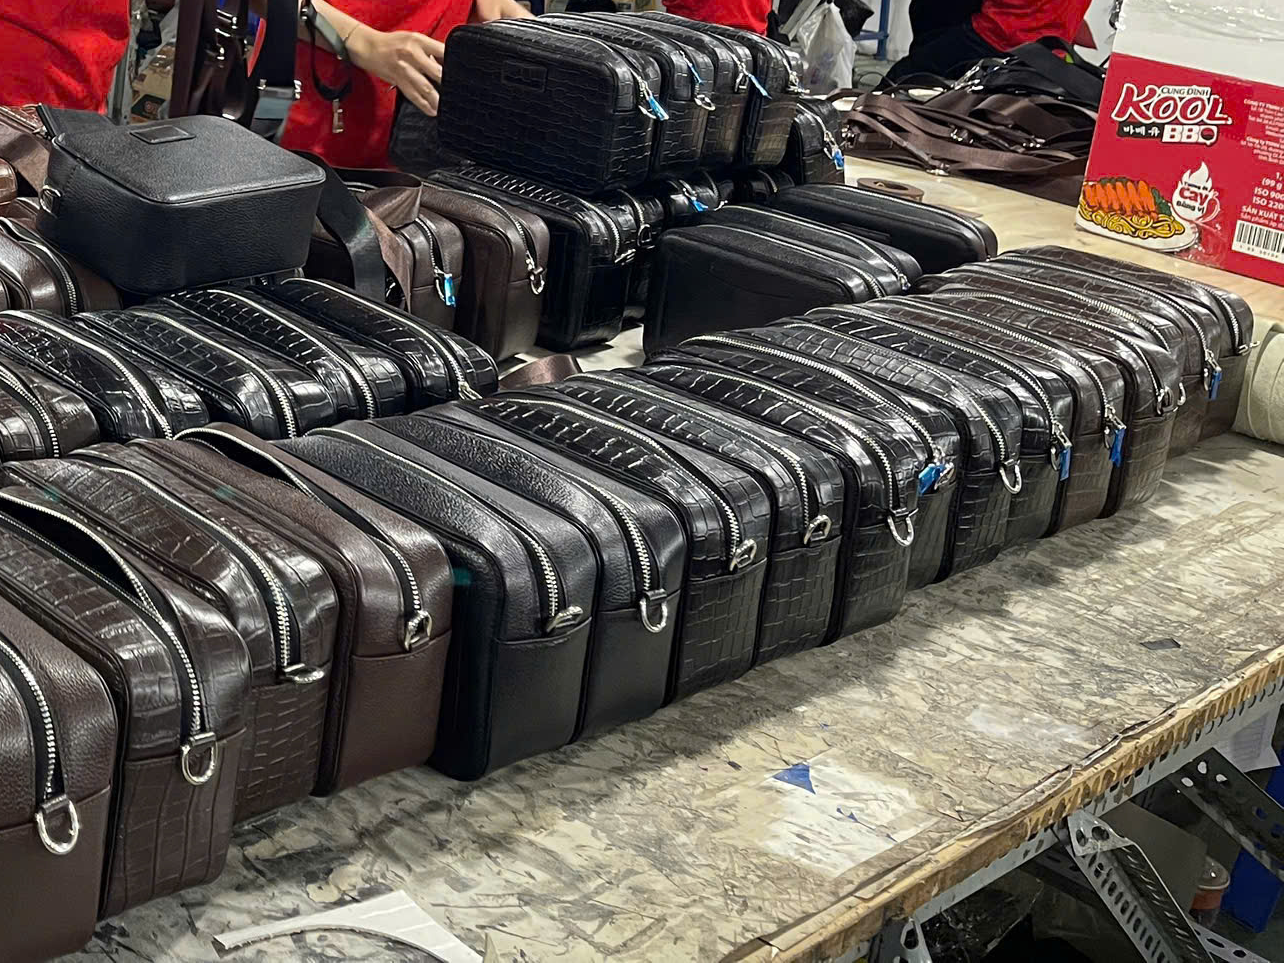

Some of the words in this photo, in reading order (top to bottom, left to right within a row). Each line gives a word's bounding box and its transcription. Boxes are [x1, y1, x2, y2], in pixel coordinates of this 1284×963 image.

[1161, 87, 1185, 96] CUNG
[1111, 83, 1232, 125] KOOL
[1162, 124, 1218, 146] BBQ
[1179, 187, 1209, 206] Cay
[1254, 187, 1269, 197] ISO
[1252, 196, 1267, 206] ISO
